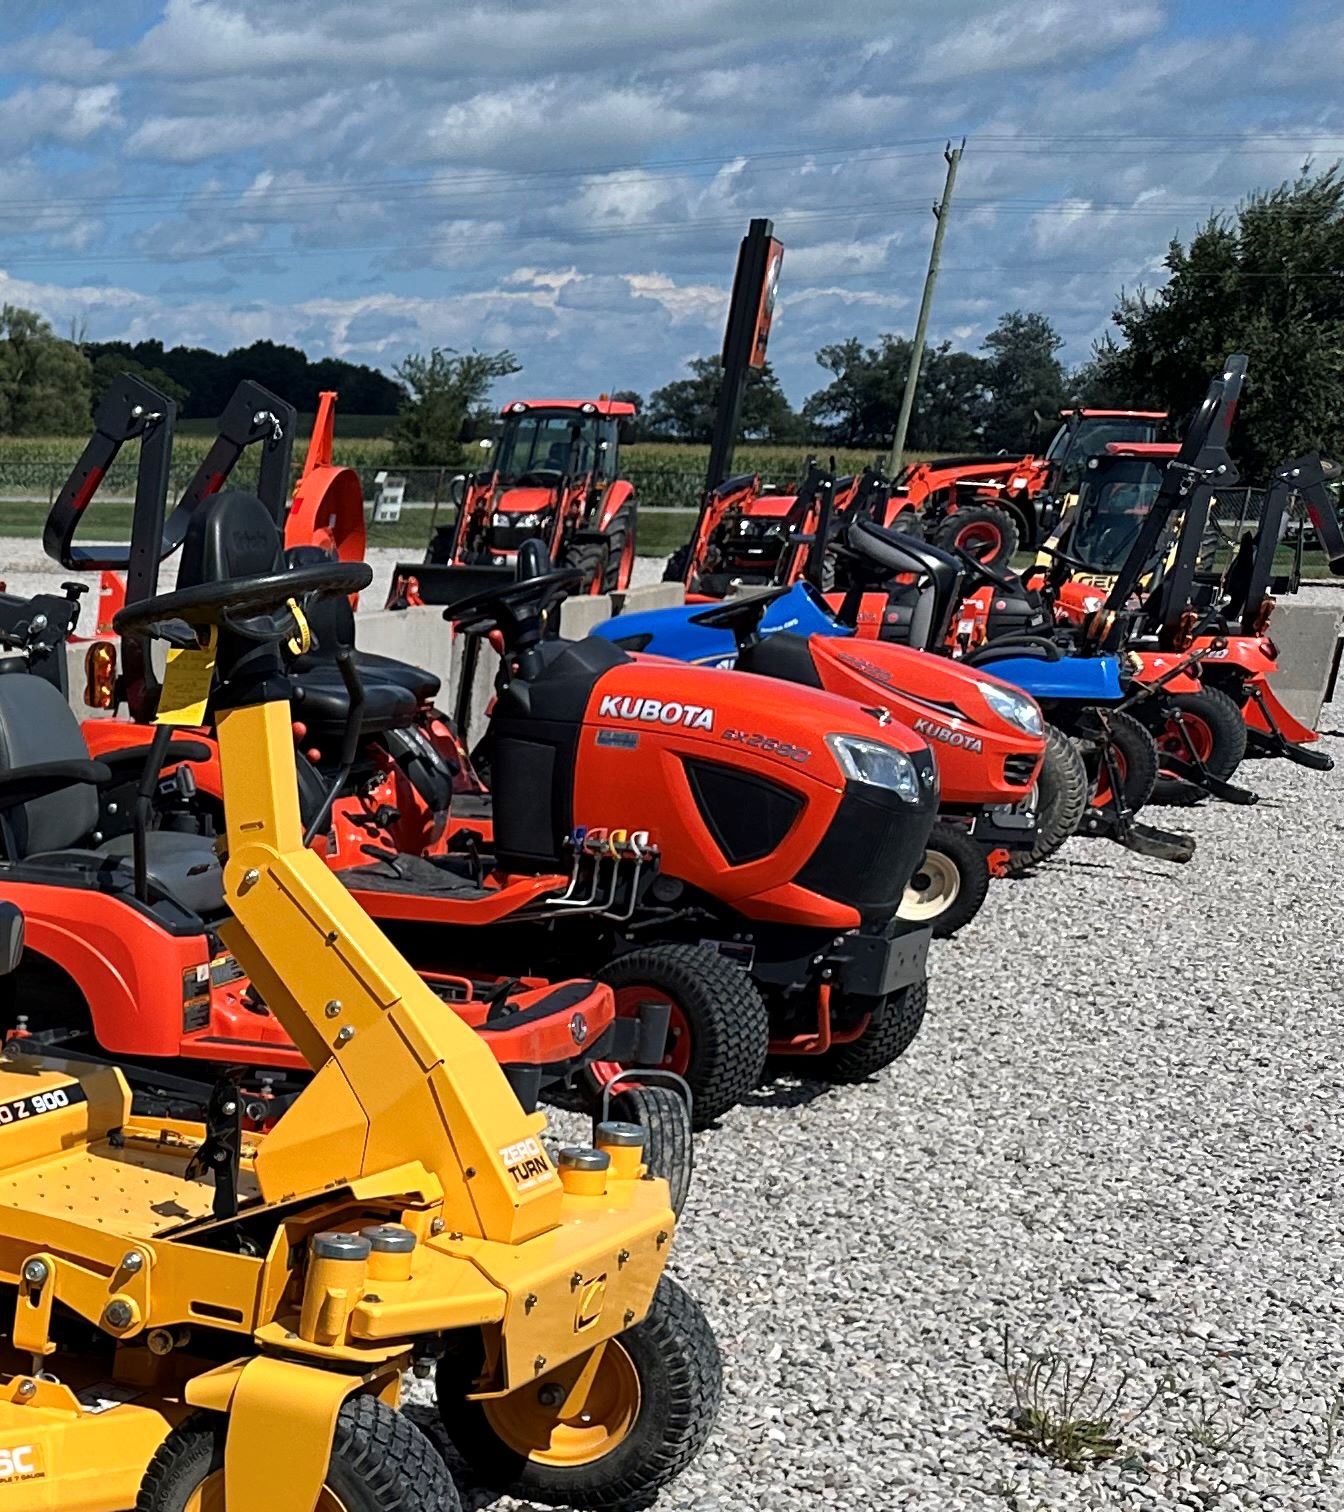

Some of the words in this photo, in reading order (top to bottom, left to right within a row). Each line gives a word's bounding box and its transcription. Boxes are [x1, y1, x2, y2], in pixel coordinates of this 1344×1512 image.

[599, 694, 715, 732] KUBOTA
[912, 717, 984, 755] KUBOTA
[13, 1100, 30, 1120] Z
[32, 1088, 69, 1114] 900
[498, 1137, 540, 1166] ZERO
[507, 1155, 549, 1184] TURN
